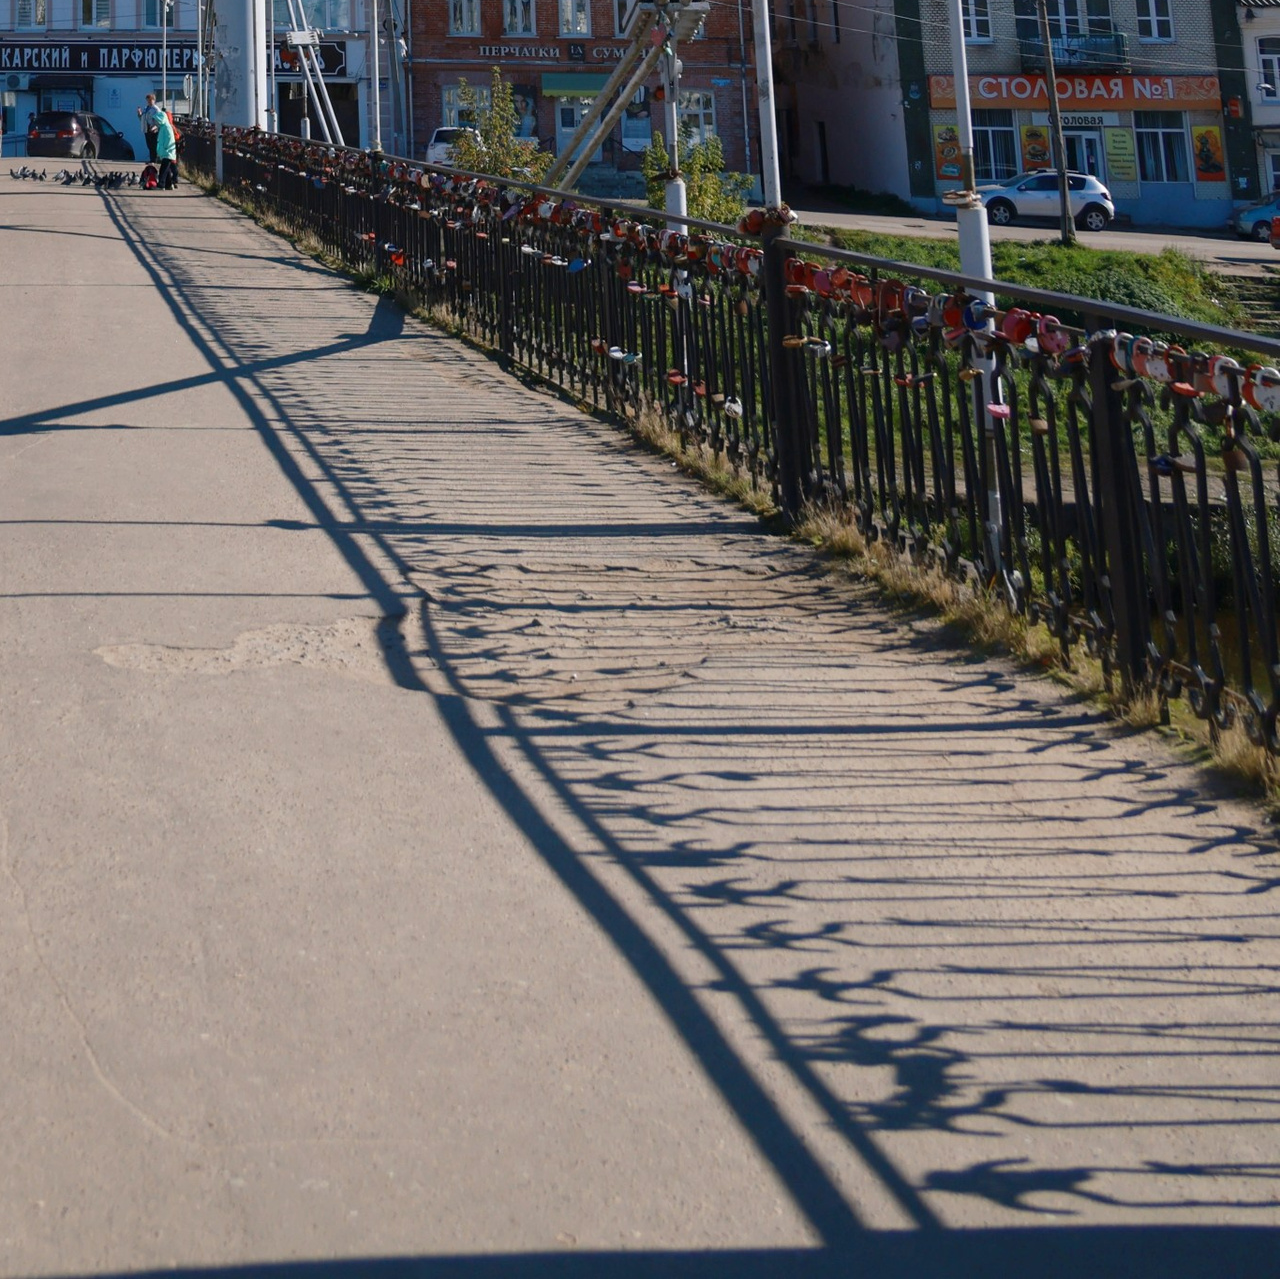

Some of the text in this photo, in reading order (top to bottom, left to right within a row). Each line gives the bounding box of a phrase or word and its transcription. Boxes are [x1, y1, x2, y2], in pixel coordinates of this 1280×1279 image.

[479, 45, 560, 58] ПЕРЧАТКИ
[978, 77, 1174, 99] СТОЛОВАЯ №1
